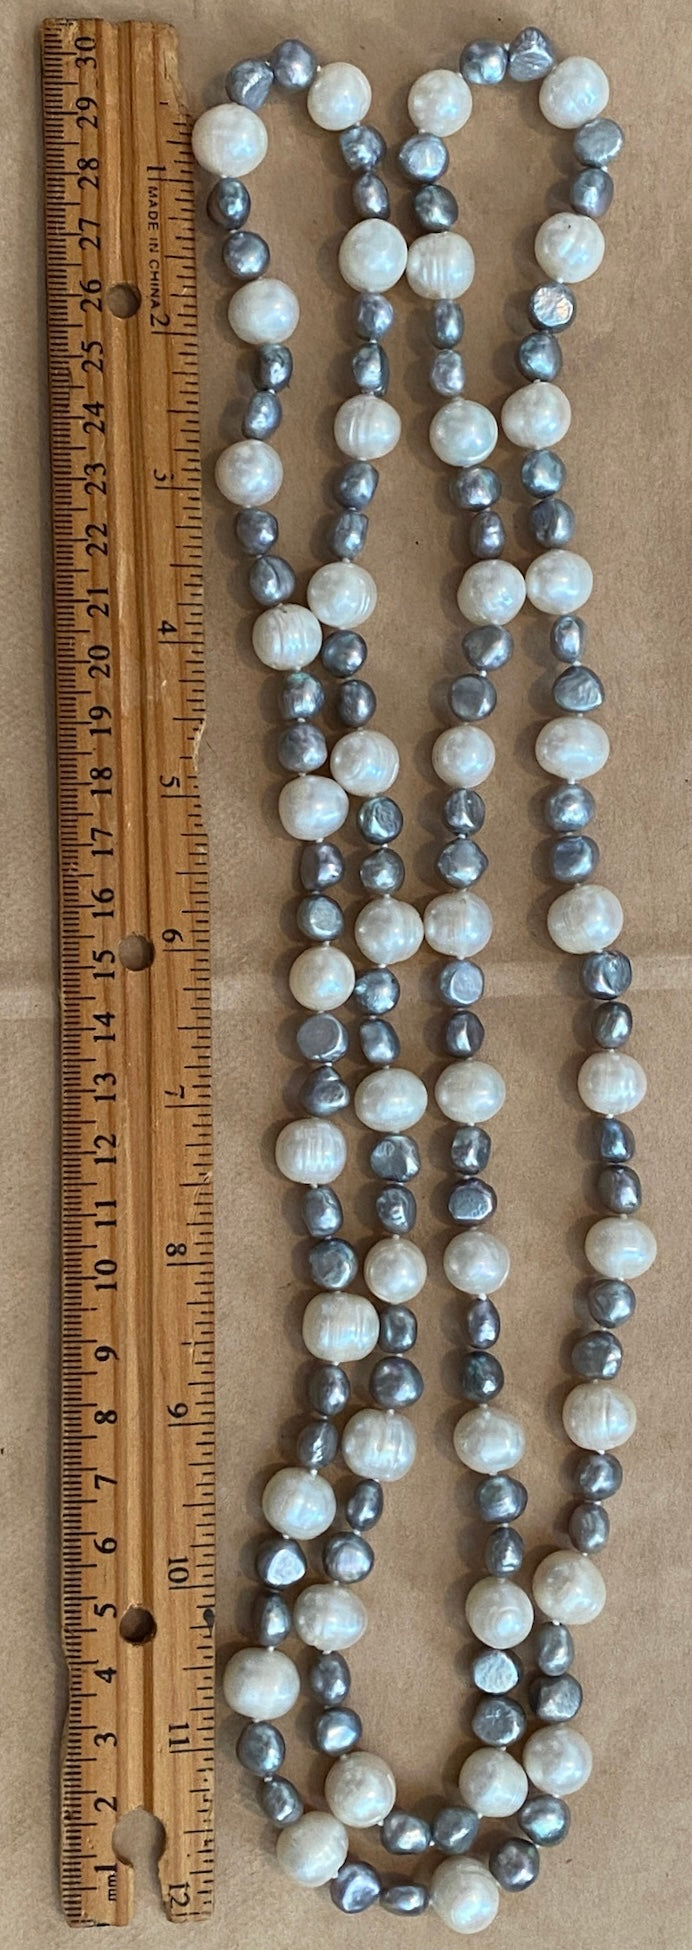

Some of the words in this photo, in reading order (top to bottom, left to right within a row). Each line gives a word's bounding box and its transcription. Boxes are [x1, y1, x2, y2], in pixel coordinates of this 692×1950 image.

[75, 36, 97, 69] 30
[76, 96, 98, 129] 29
[77, 157, 99, 190] 28
[148, 186, 159, 231] MADE
[78, 218, 100, 250] 27
[150, 238, 159, 253] IN
[80, 279, 102, 313] 26
[149, 259, 160, 310] CHINA
[150, 313, 170, 327] 2
[81, 340, 104, 373] 25
[83, 401, 105, 434] 24
[84, 462, 107, 495] 23
[85, 523, 108, 556] 22
[87, 587, 109, 618] 21
[158, 620, 177, 635] 4
[88, 645, 110, 679] 20
[89, 706, 112, 737] 19
[90, 766, 112, 796] 18
[159, 775, 180, 788] 5
[91, 827, 114, 857] 17
[91, 888, 115, 918] 16
[162, 928, 184, 944] 6
[93, 950, 115, 980] 15
[93, 1011, 116, 1042] 14
[94, 1072, 116, 1102] 13
[164, 1085, 185, 1099] 7
[94, 1134, 117, 1165] 12
[94, 1200, 117, 1228] 11
[166, 1243, 187, 1256] 8
[94, 1259, 118, 1292] 10
[94, 1346, 119, 1362] 9
[94, 1409, 118, 1425] 8
[166, 1403, 189, 1418] 9
[94, 1474, 118, 1490] 7
[94, 1537, 118, 1554] 6
[168, 1556, 190, 1584] 10
[94, 1603, 117, 1618] 5
[94, 1667, 117, 1684] 4
[94, 1732, 117, 1747] 3
[168, 1722, 190, 1747] 11
[94, 1796, 117, 1812] 2
[94, 1863, 117, 1874] 1
[107, 1875, 117, 1901] mm
[168, 1882, 191, 1908] 12
